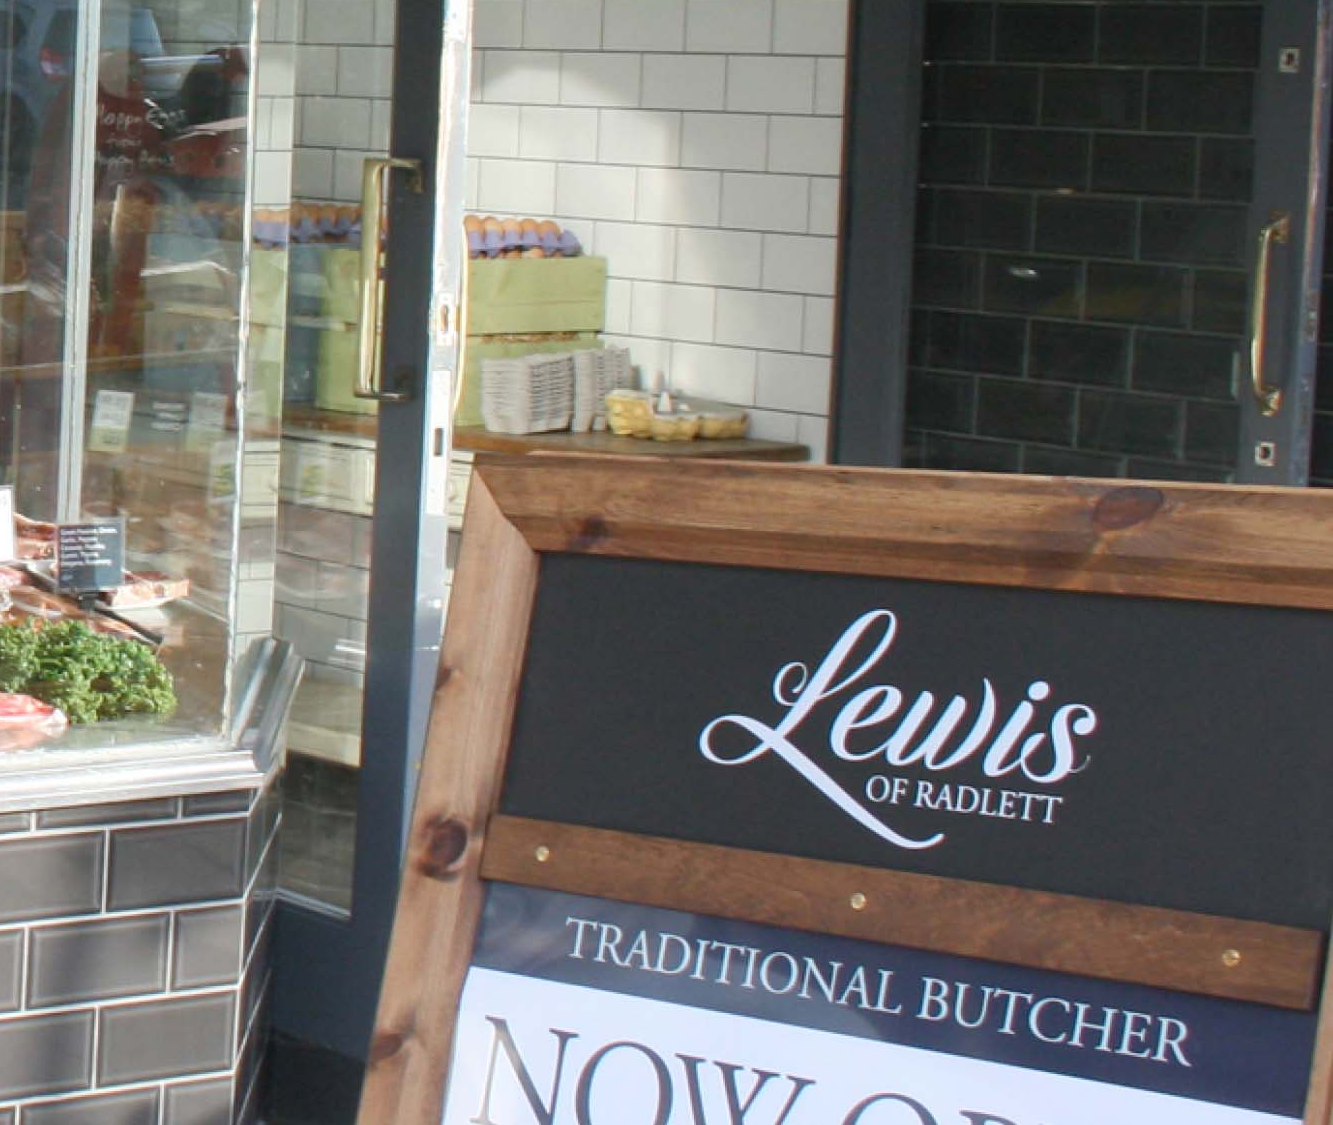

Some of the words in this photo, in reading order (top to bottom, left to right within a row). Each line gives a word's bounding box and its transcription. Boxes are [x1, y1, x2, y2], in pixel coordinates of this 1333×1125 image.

[699, 608, 1097, 850] Lewis
[865, 775, 909, 805] OF
[913, 779, 1064, 824] RADLETT
[566, 917, 902, 1015] TRADITIONAL
[916, 976, 1192, 1067] BUTCHER
[469, 1014, 816, 1125] NOW
